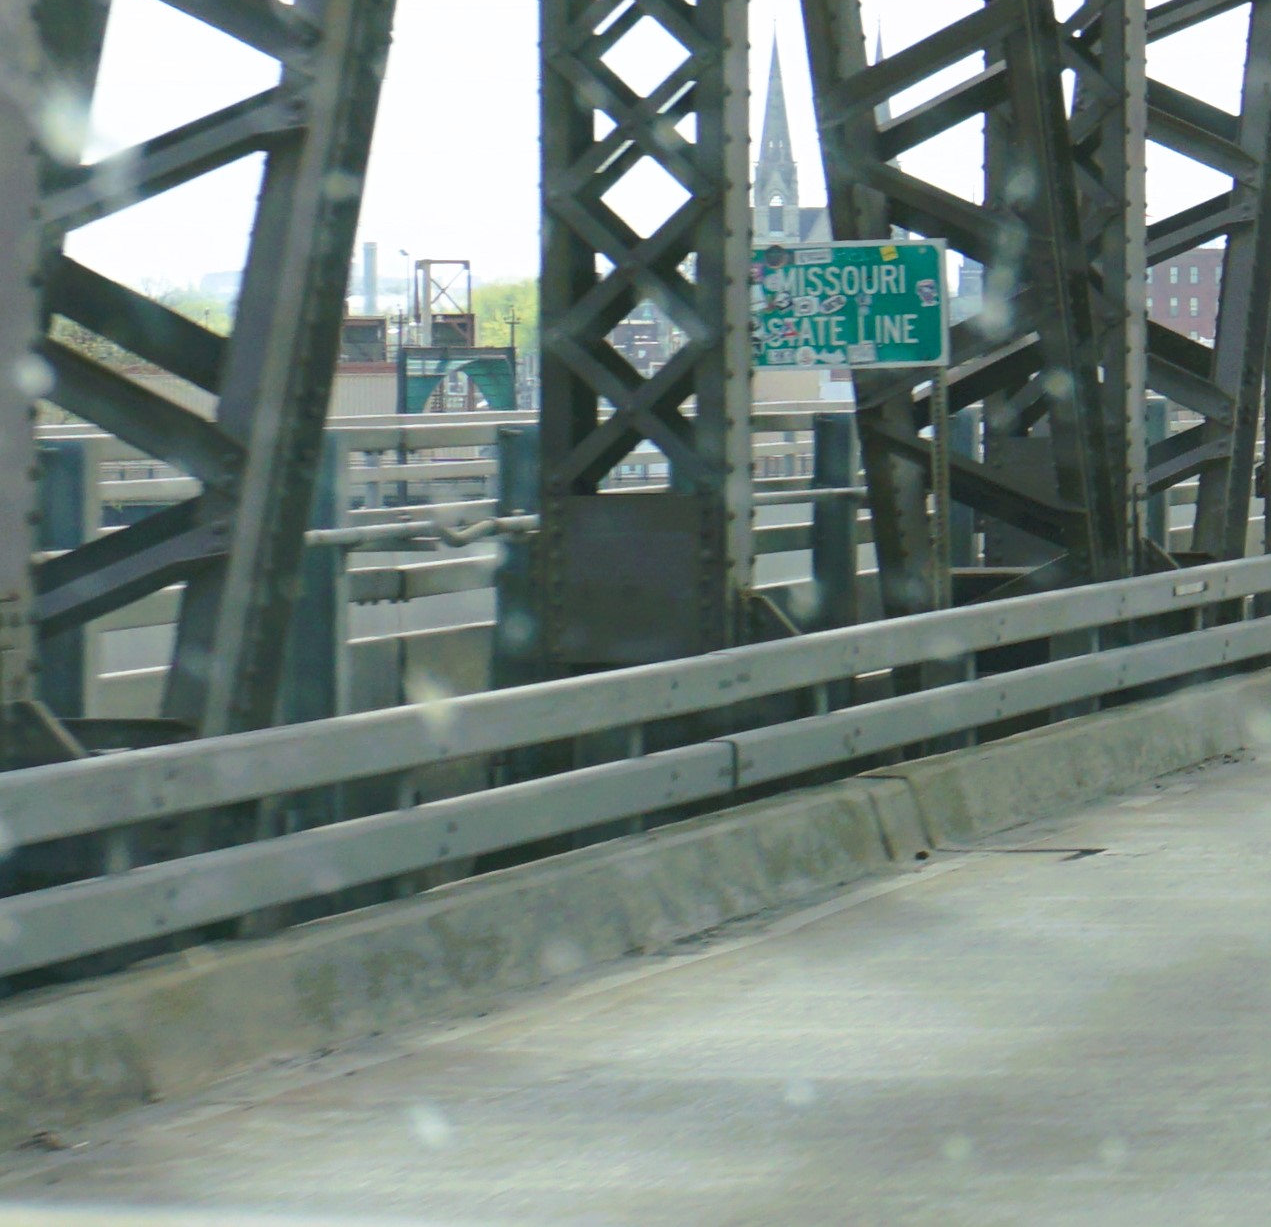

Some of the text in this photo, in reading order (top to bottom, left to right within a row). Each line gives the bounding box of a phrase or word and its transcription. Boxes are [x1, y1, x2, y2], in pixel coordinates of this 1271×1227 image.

[776, 265, 906, 297] MISSOURI
[767, 314, 919, 347] STATE LINE
